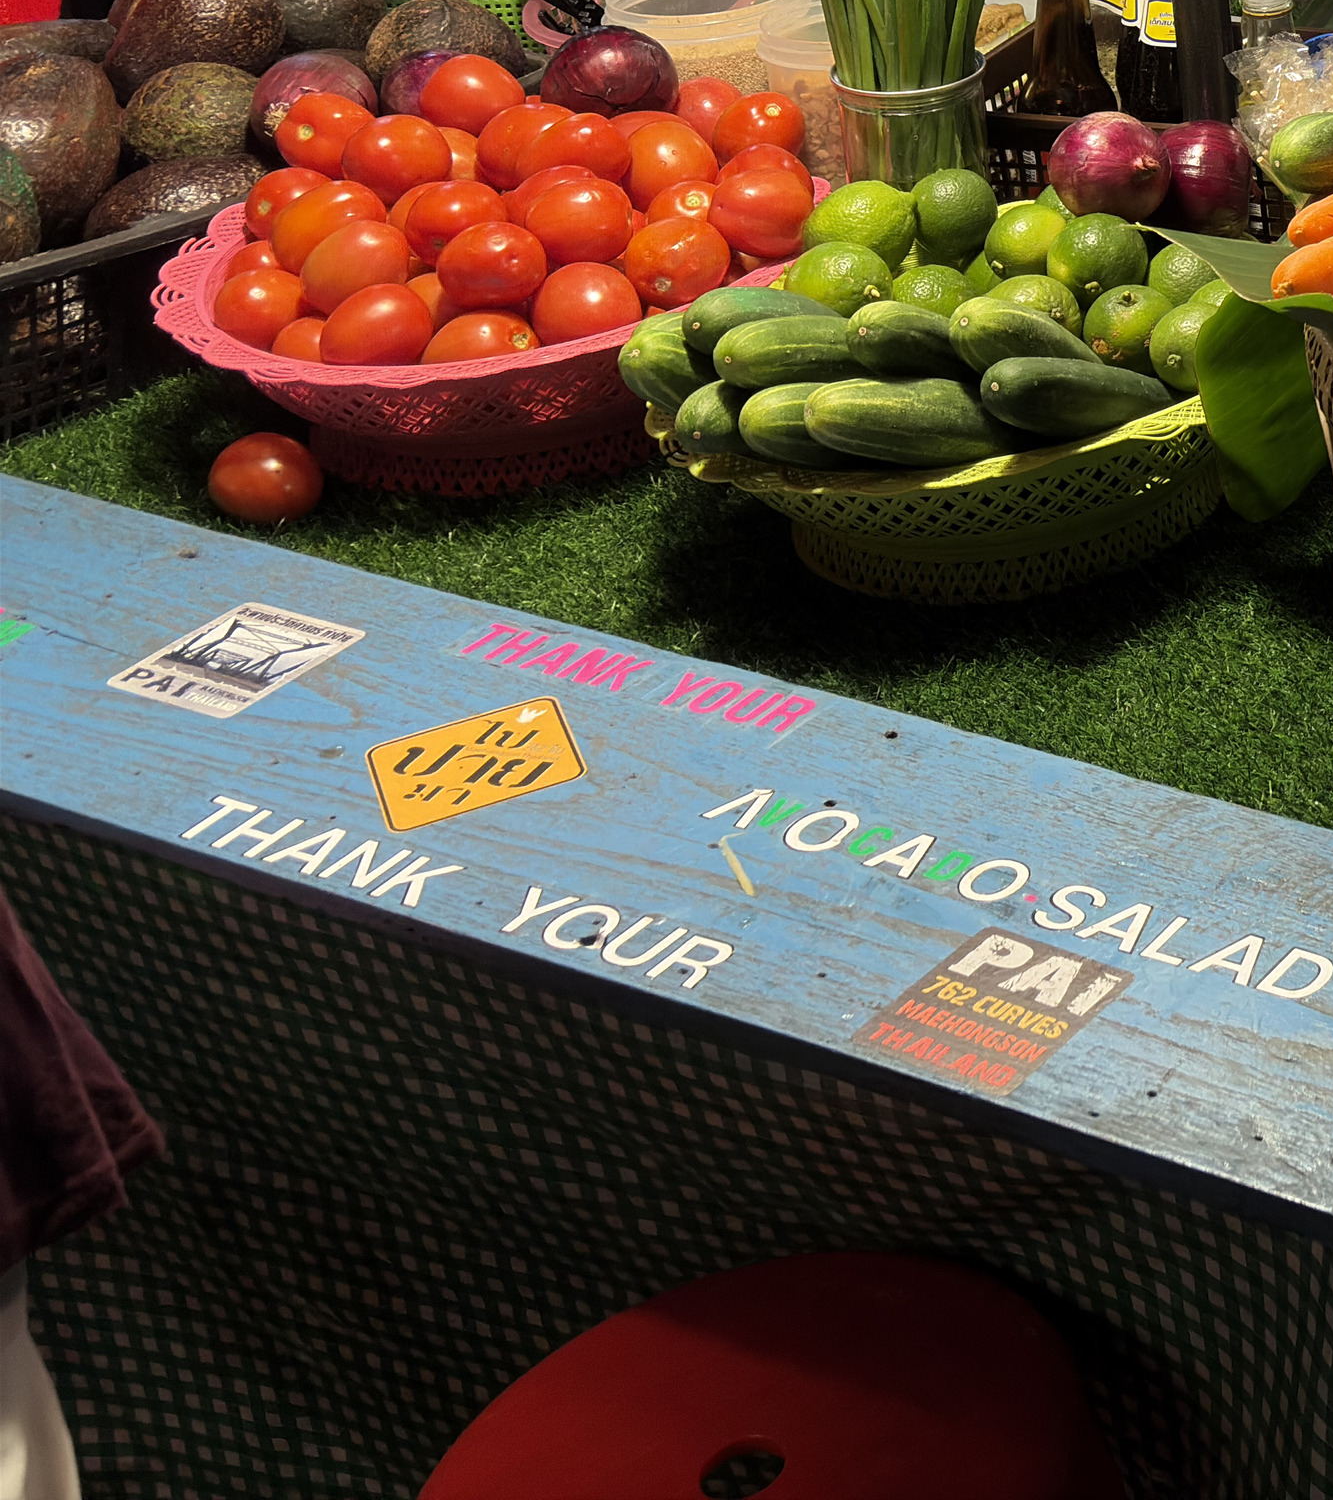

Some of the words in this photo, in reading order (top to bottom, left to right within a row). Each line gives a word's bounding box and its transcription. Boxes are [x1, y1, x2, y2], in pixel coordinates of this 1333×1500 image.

[121, 667, 196, 698] PAI
[461, 623, 655, 692] THANK
[659, 672, 817, 734] YOUR
[393, 744, 554, 788] ปาย
[474, 719, 540, 749] ไป
[180, 795, 466, 908] THANK
[501, 885, 735, 990] YOUR
[921, 974, 968, 1007] 762
[971, 995, 1069, 1040] CURVES
[947, 932, 1123, 1019] PAI
[868, 1020, 1016, 1090] THAILAND
[897, 998, 1049, 1064] MAEHONGSON
